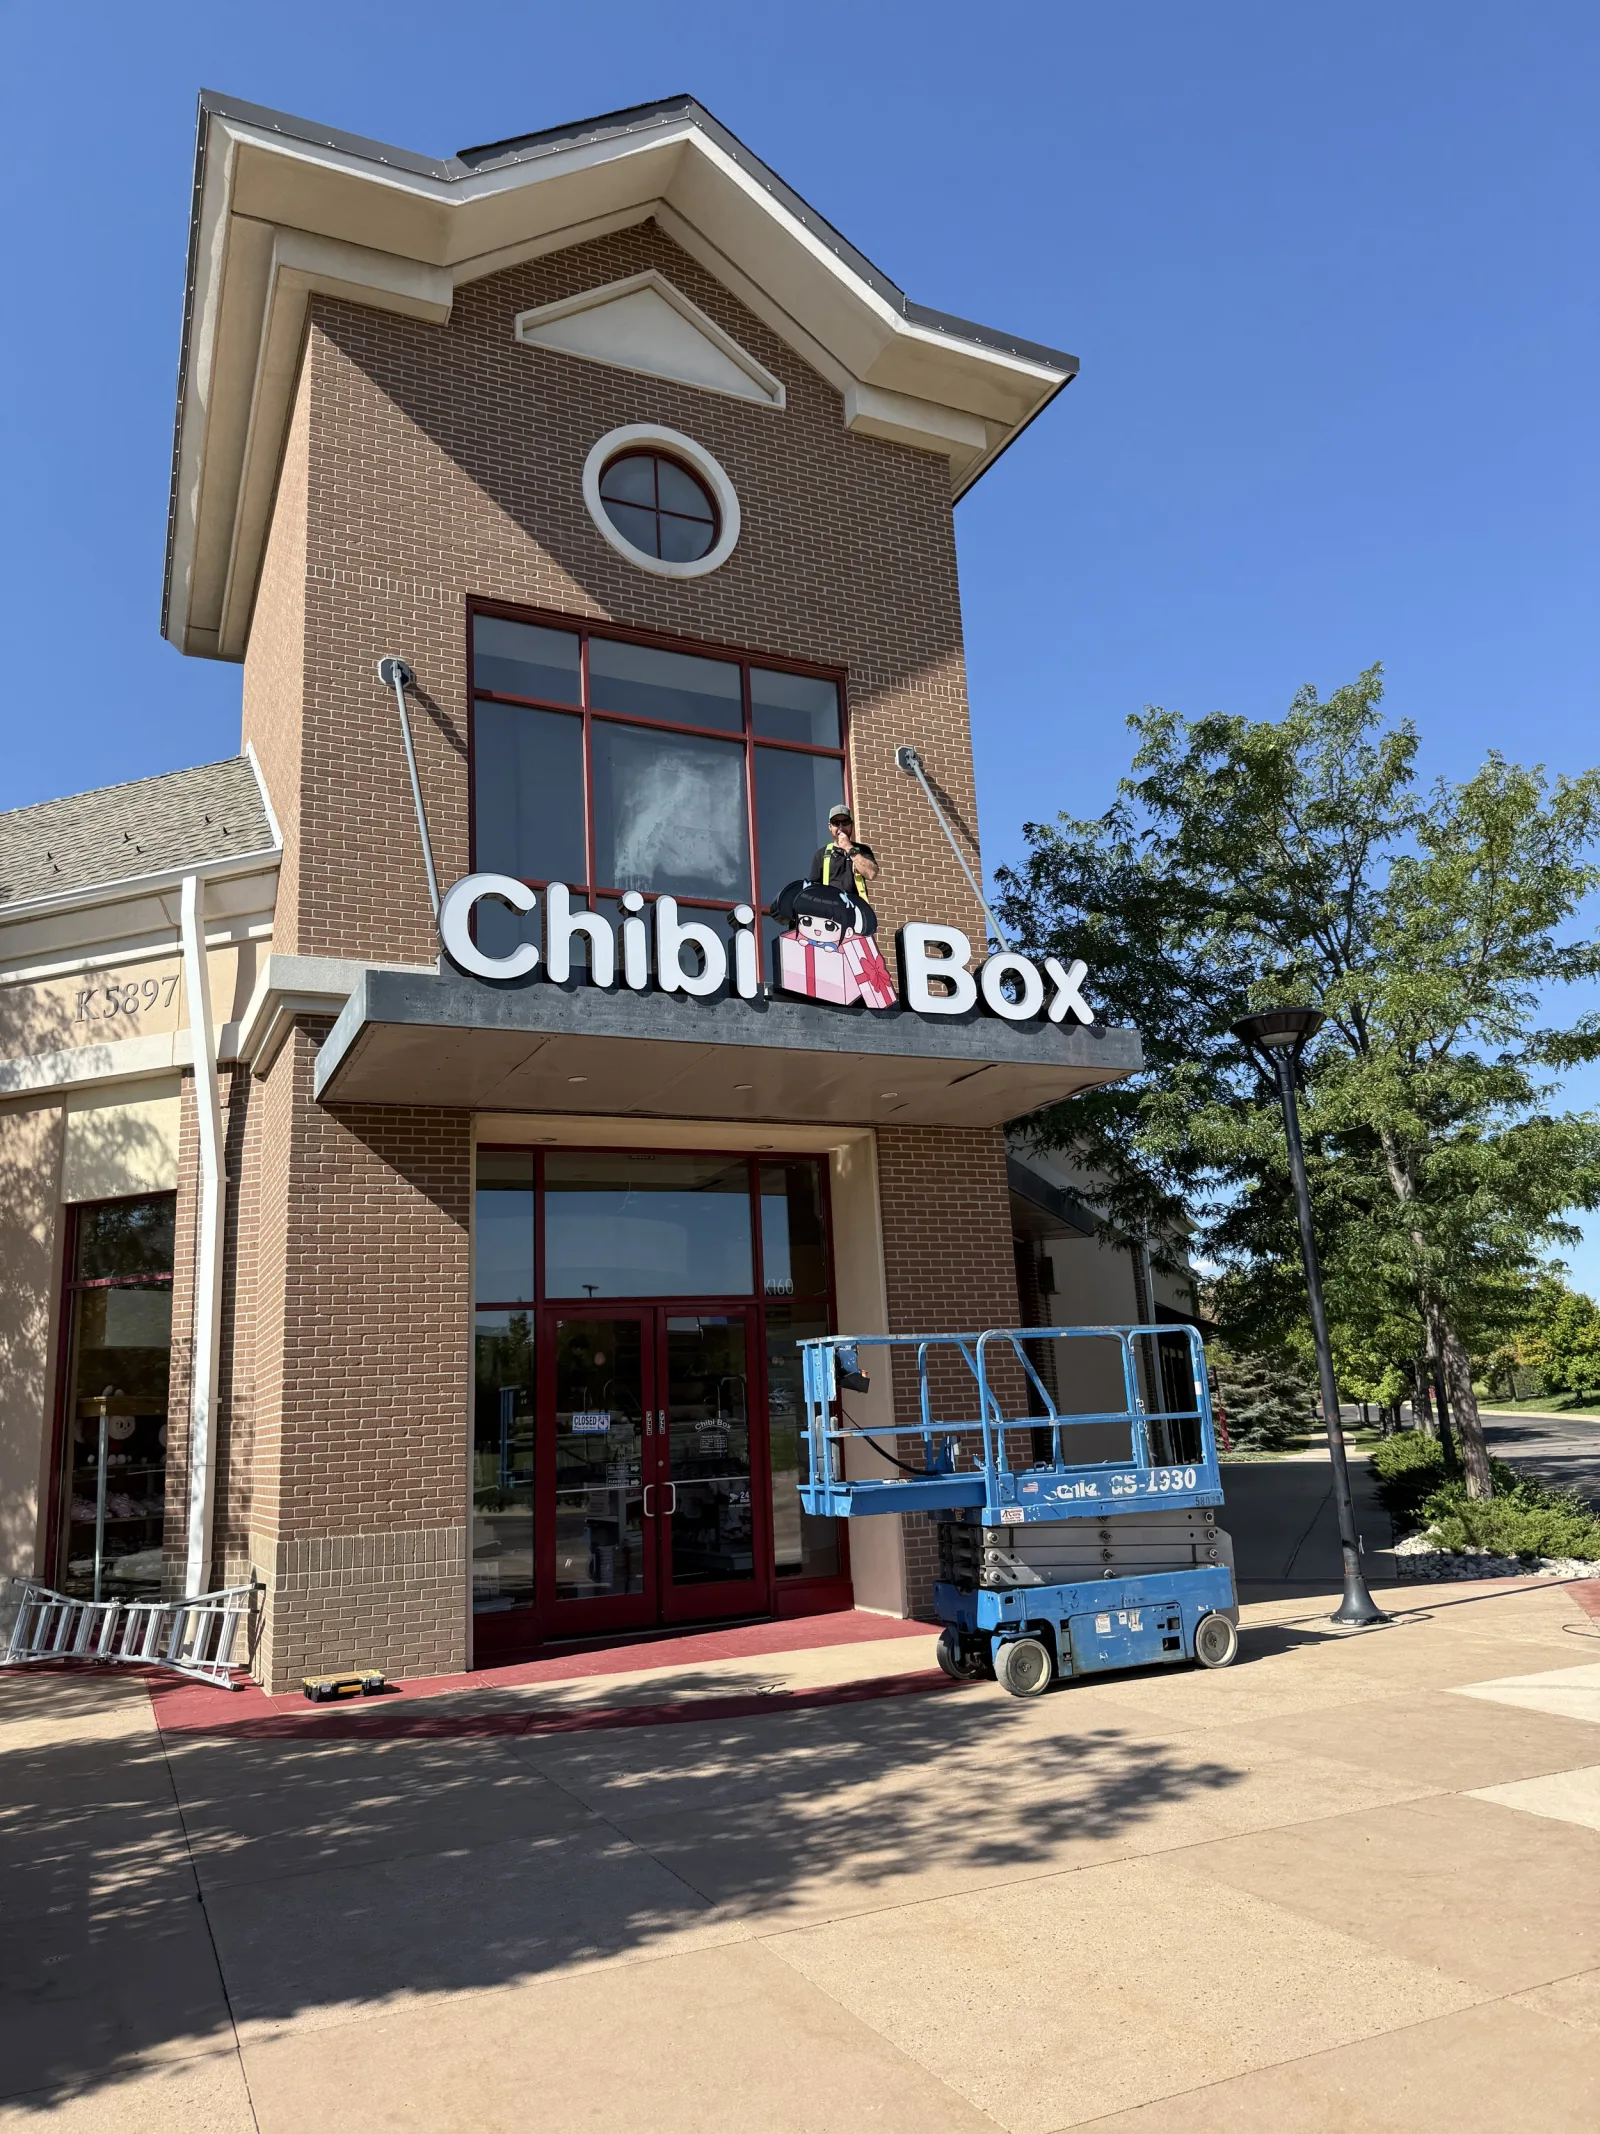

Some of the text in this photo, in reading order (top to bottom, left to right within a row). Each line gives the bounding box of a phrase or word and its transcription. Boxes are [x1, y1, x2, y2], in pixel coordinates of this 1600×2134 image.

[437, 872, 1096, 1025] Chibi Box
[764, 1277, 794, 1296] K160
[574, 1416, 597, 1426] CLOSED
[694, 1418, 732, 1430] Chibi Box
